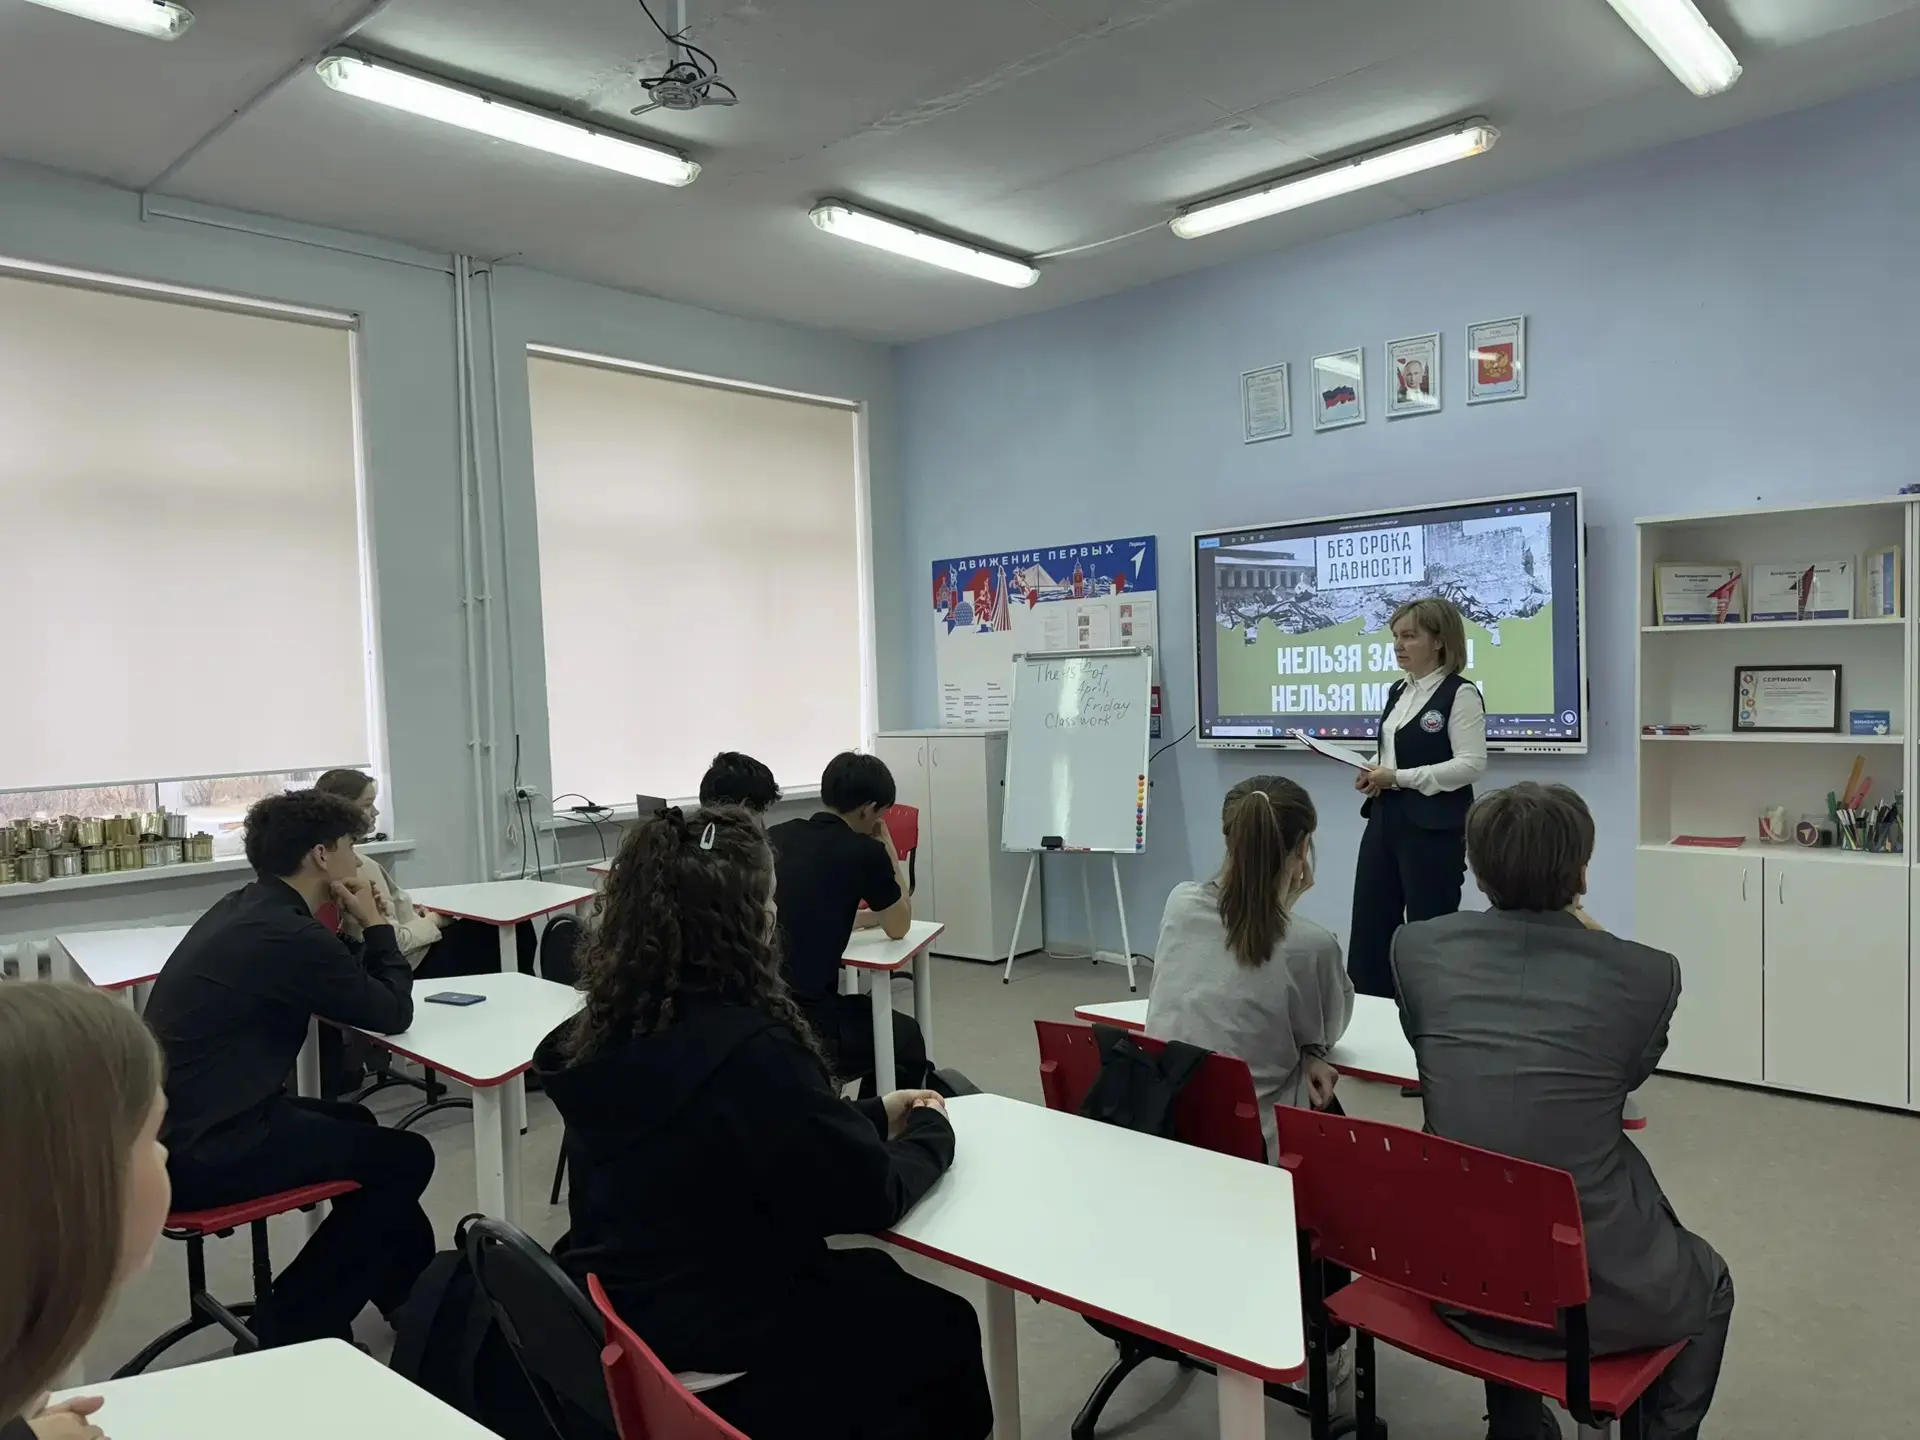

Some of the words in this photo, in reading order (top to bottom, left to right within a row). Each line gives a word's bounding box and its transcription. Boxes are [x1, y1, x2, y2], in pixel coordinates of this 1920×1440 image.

[958, 553, 1040, 571] ДВИЖЕНИЕ
[1049, 544, 1114, 560] ПЕРВЫХ
[1328, 538, 1354, 558] БЕЗ
[1360, 532, 1411, 555] СРОКА
[1329, 556, 1412, 584] ДАВНОСТИ
[1277, 644, 1362, 674] НЕЛЬЗЯ
[1027, 663, 1060, 683] The
[1092, 664, 1108, 685] of
[1083, 697, 1131, 720] Friday
[1271, 684, 1355, 712] НЕЛЬЗЯ
